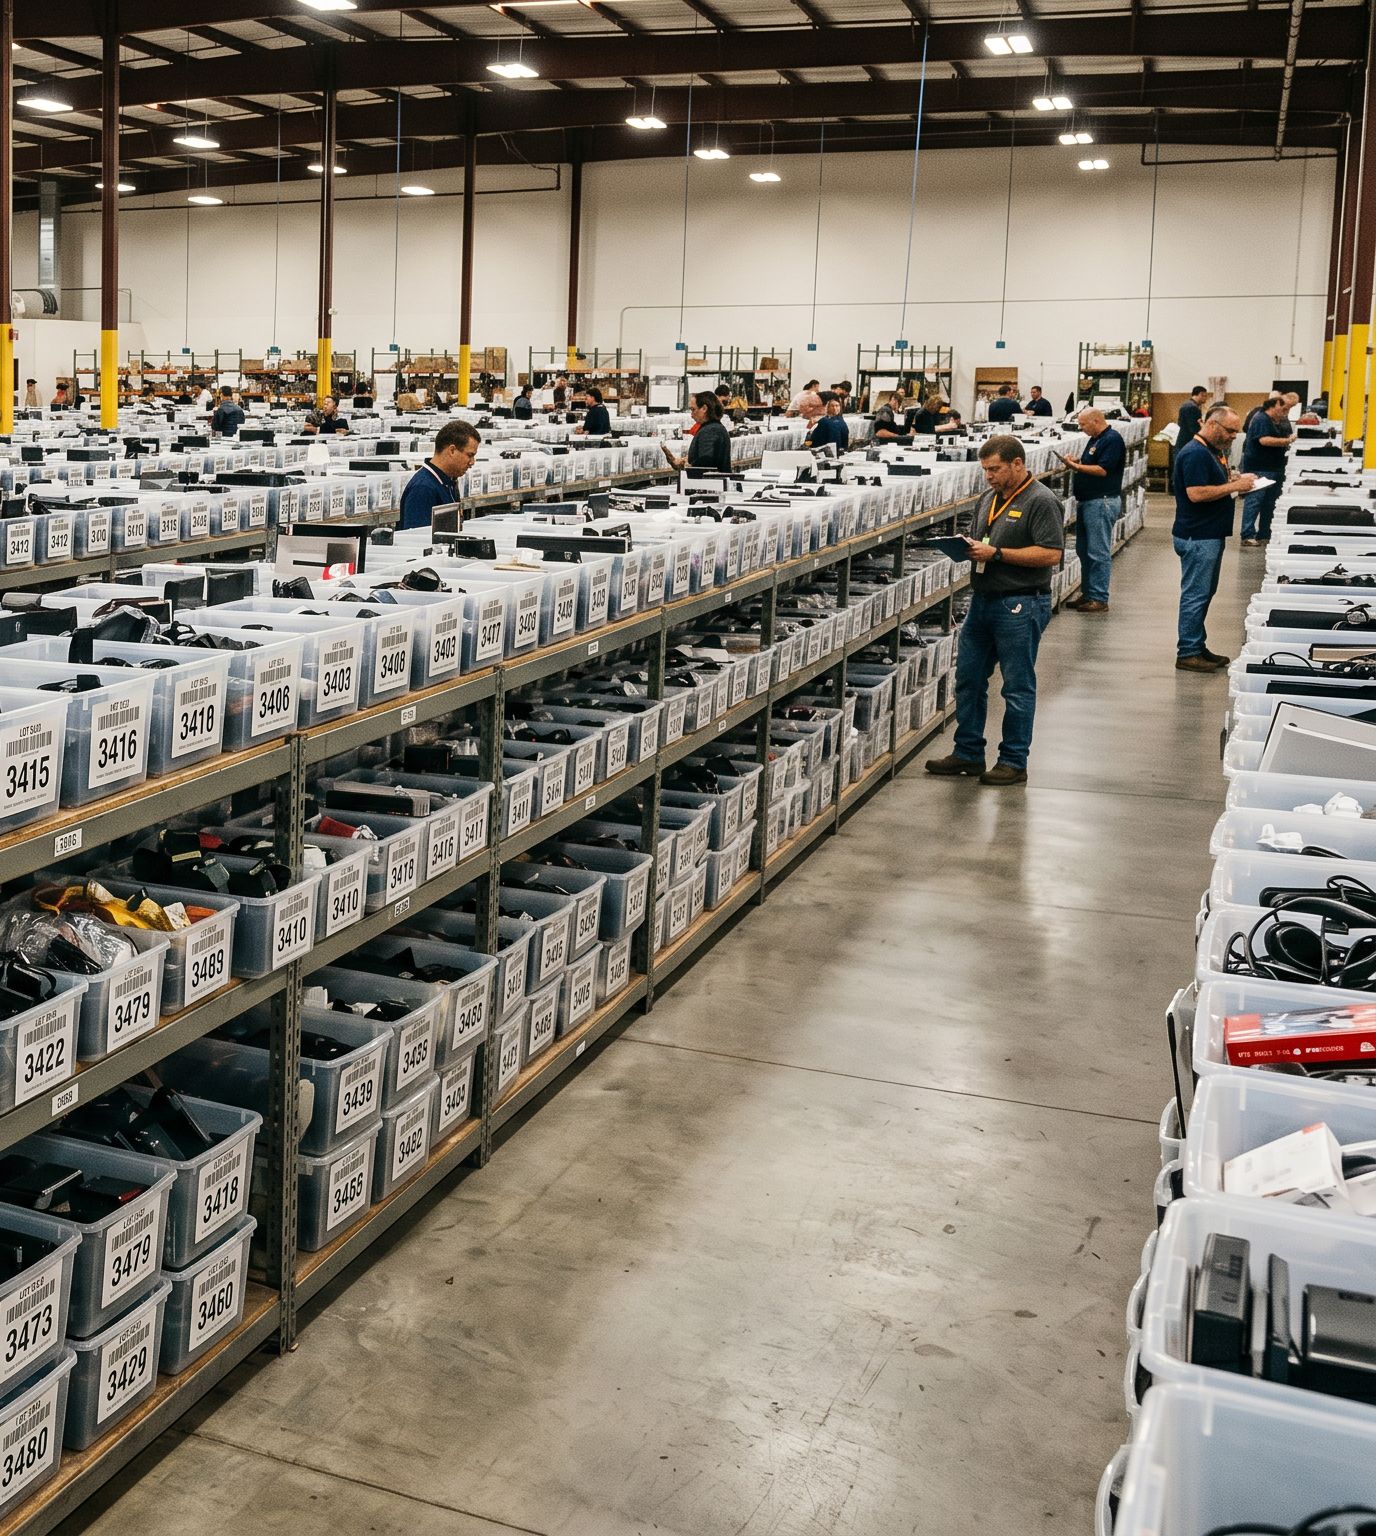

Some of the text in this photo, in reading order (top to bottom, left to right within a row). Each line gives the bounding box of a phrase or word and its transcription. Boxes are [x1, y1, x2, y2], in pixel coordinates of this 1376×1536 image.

[323, 666, 351, 697] 3403
[98, 729, 137, 768] 3416
[6, 755, 50, 798] 3415
[332, 888, 358, 920] 3410
[278, 916, 306, 952] 3410
[115, 991, 150, 1033] 3479
[25, 1038, 64, 1083] 3422
[203, 1174, 238, 1224] 3418
[112, 1231, 151, 1287] 3479
[198, 1279, 233, 1330] 3460
[5, 1301, 52, 1362] 3473
[107, 1345, 147, 1401] 3429
[2, 1424, 48, 1487] 3480
